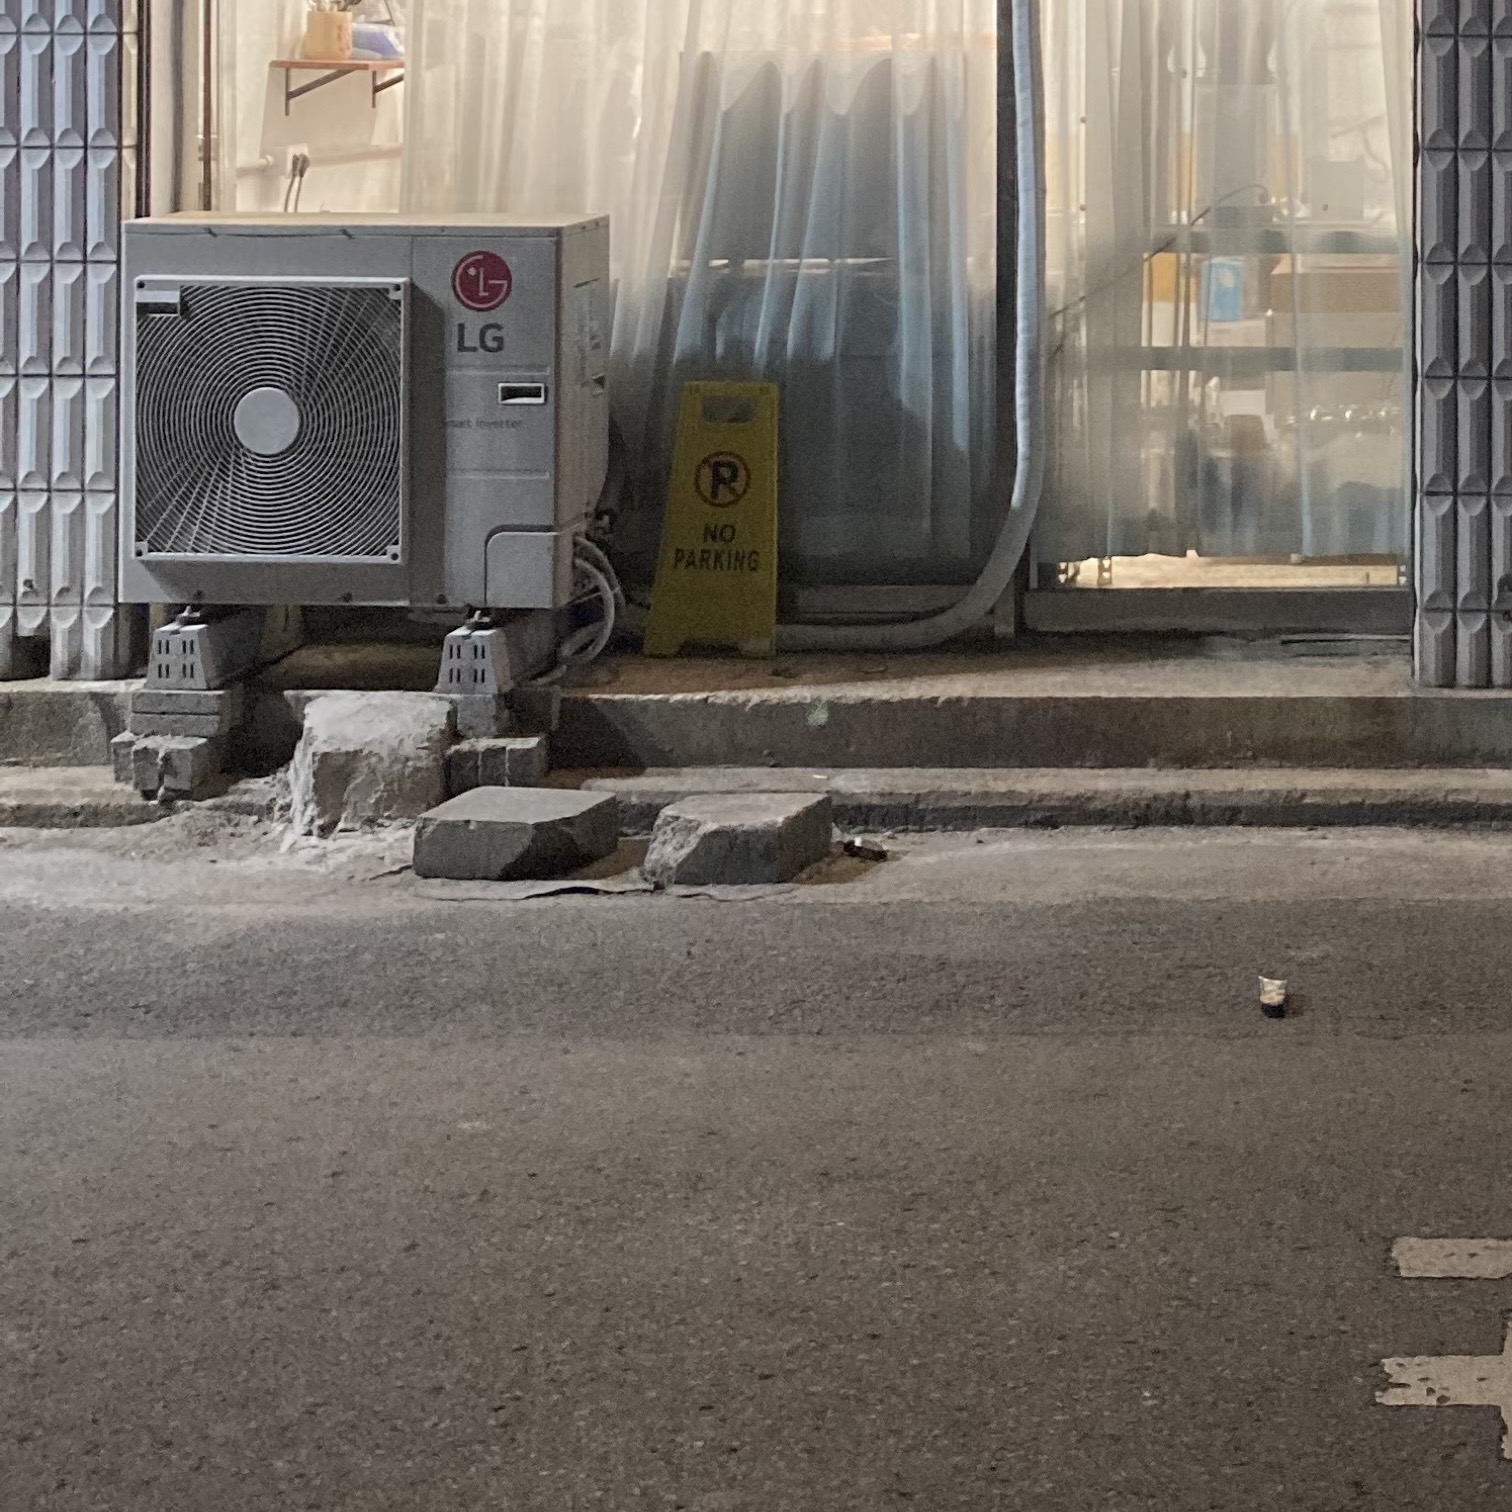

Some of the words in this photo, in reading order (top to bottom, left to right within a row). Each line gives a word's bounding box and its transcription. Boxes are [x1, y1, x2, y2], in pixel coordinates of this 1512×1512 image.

[457, 322, 505, 353] LG
[703, 523, 736, 544] NO
[673, 548, 760, 572] PARKING
